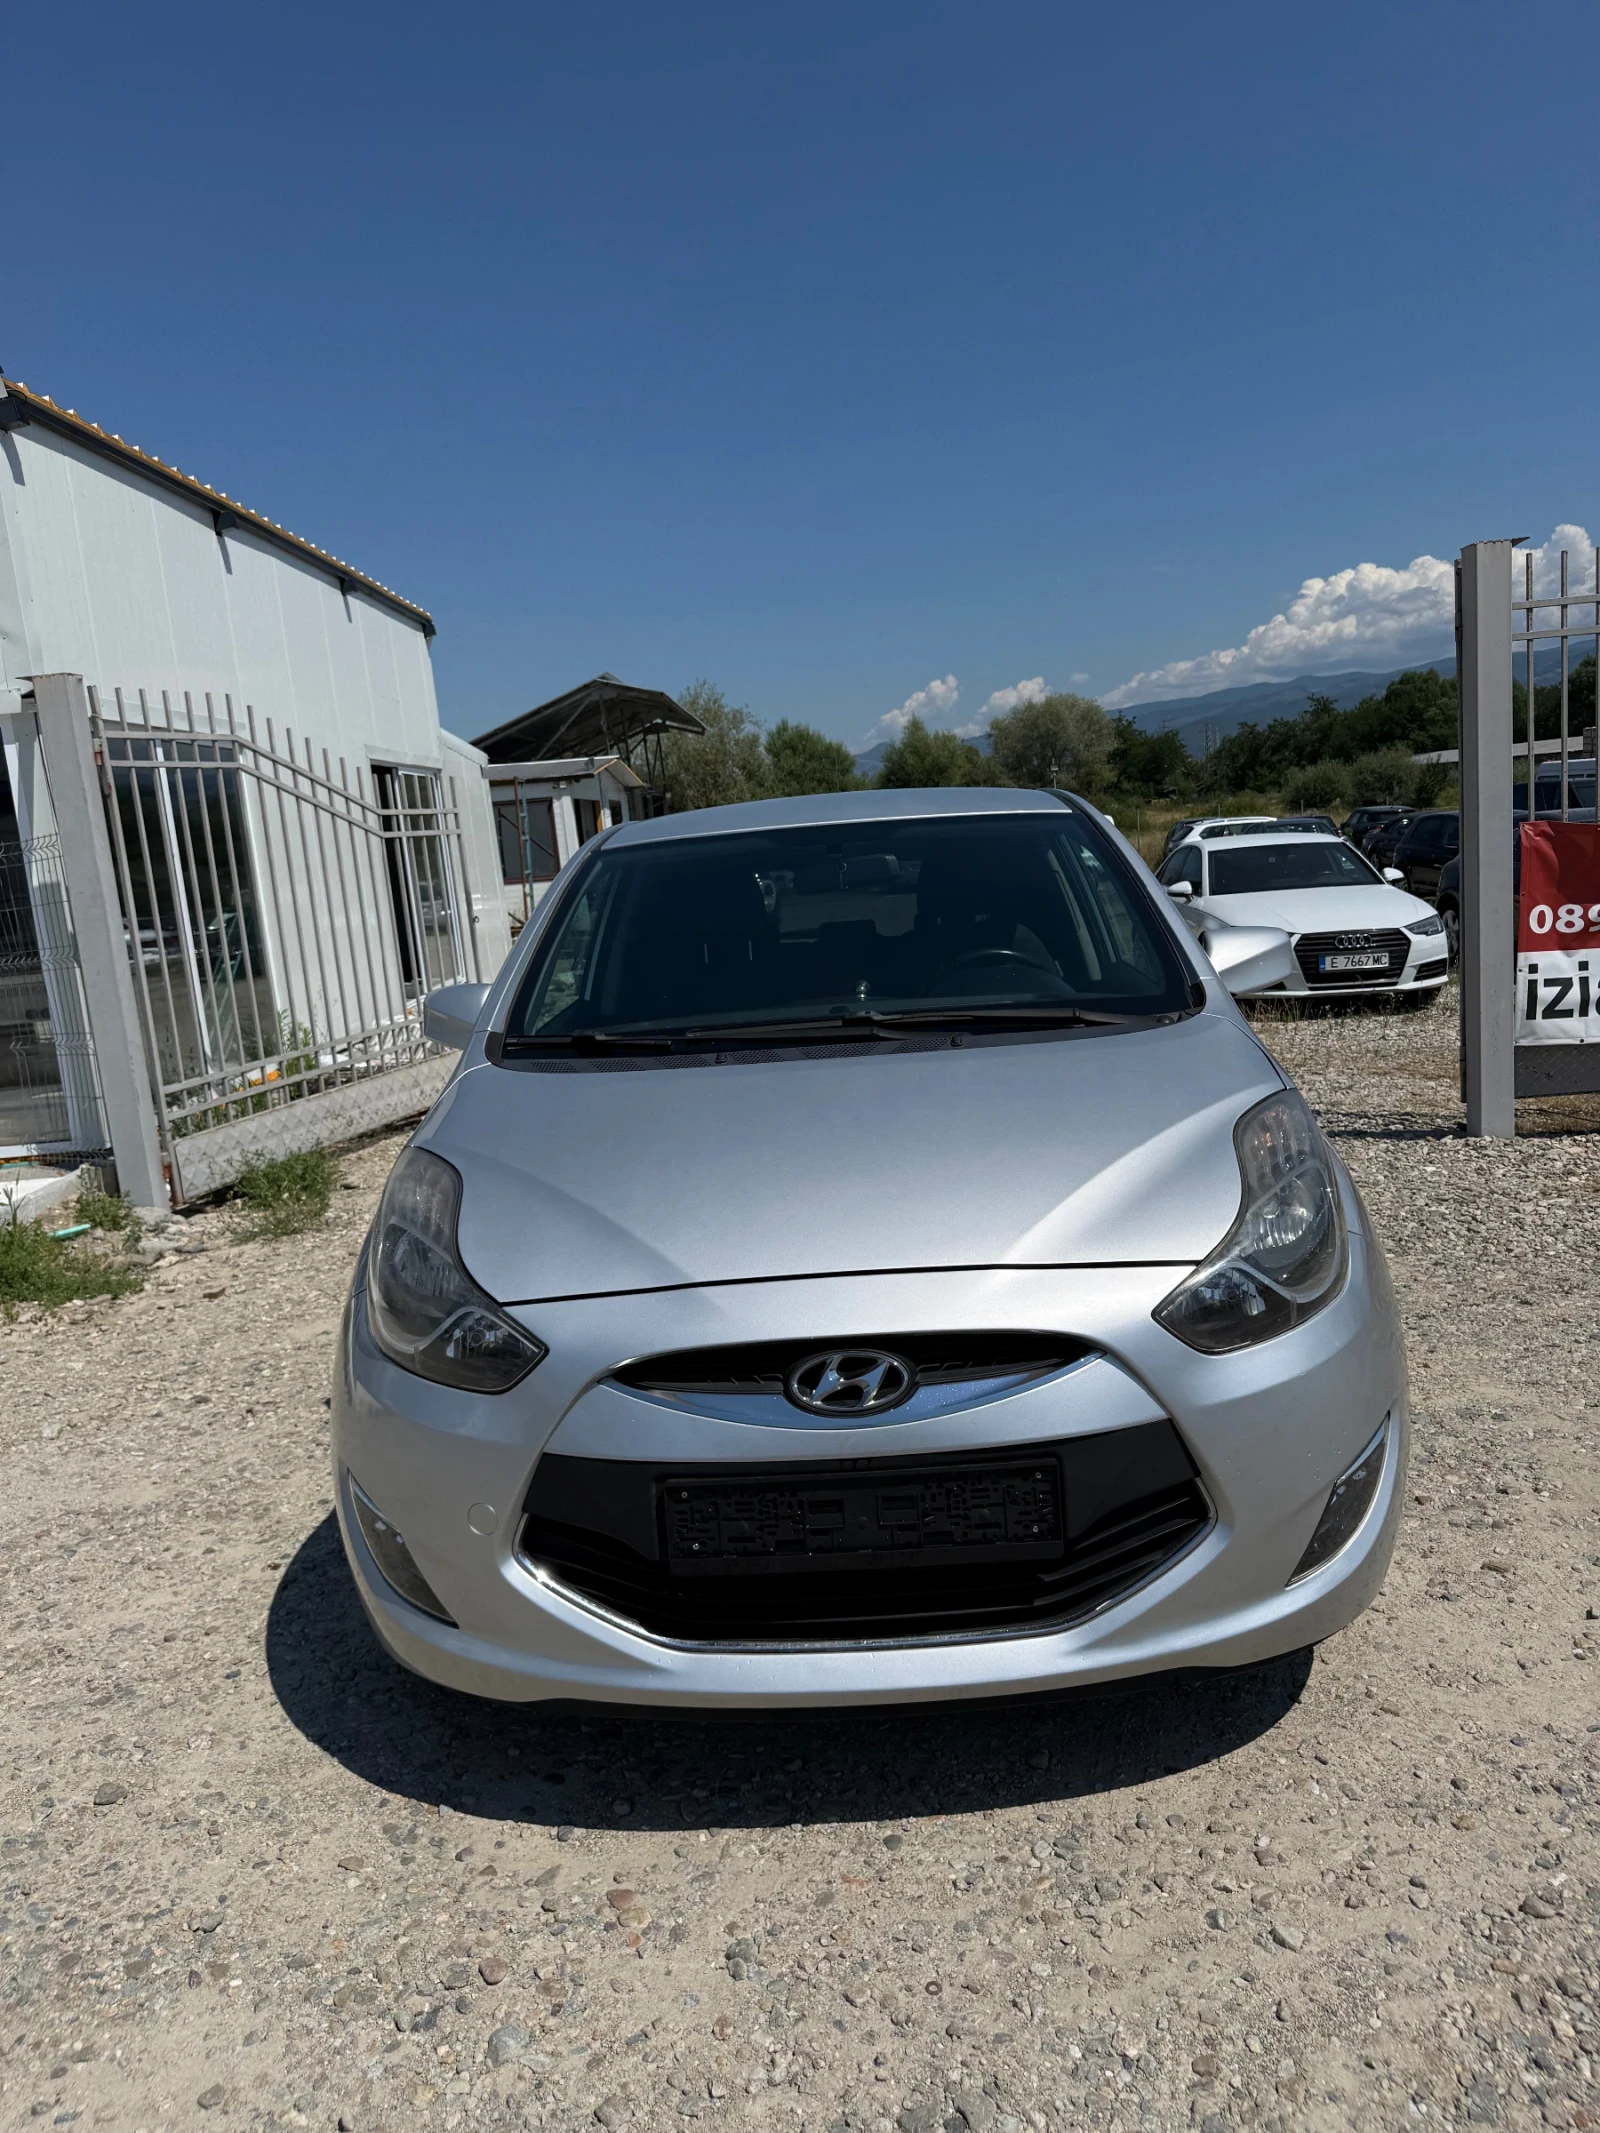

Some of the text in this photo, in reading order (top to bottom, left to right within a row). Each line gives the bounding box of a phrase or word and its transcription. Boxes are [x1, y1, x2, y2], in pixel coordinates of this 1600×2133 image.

[1331, 957, 1339, 968] E
[1344, 956, 1370, 967] 7667
[1372, 955, 1387, 965] MC
[1526, 961, 1600, 1020] izi
